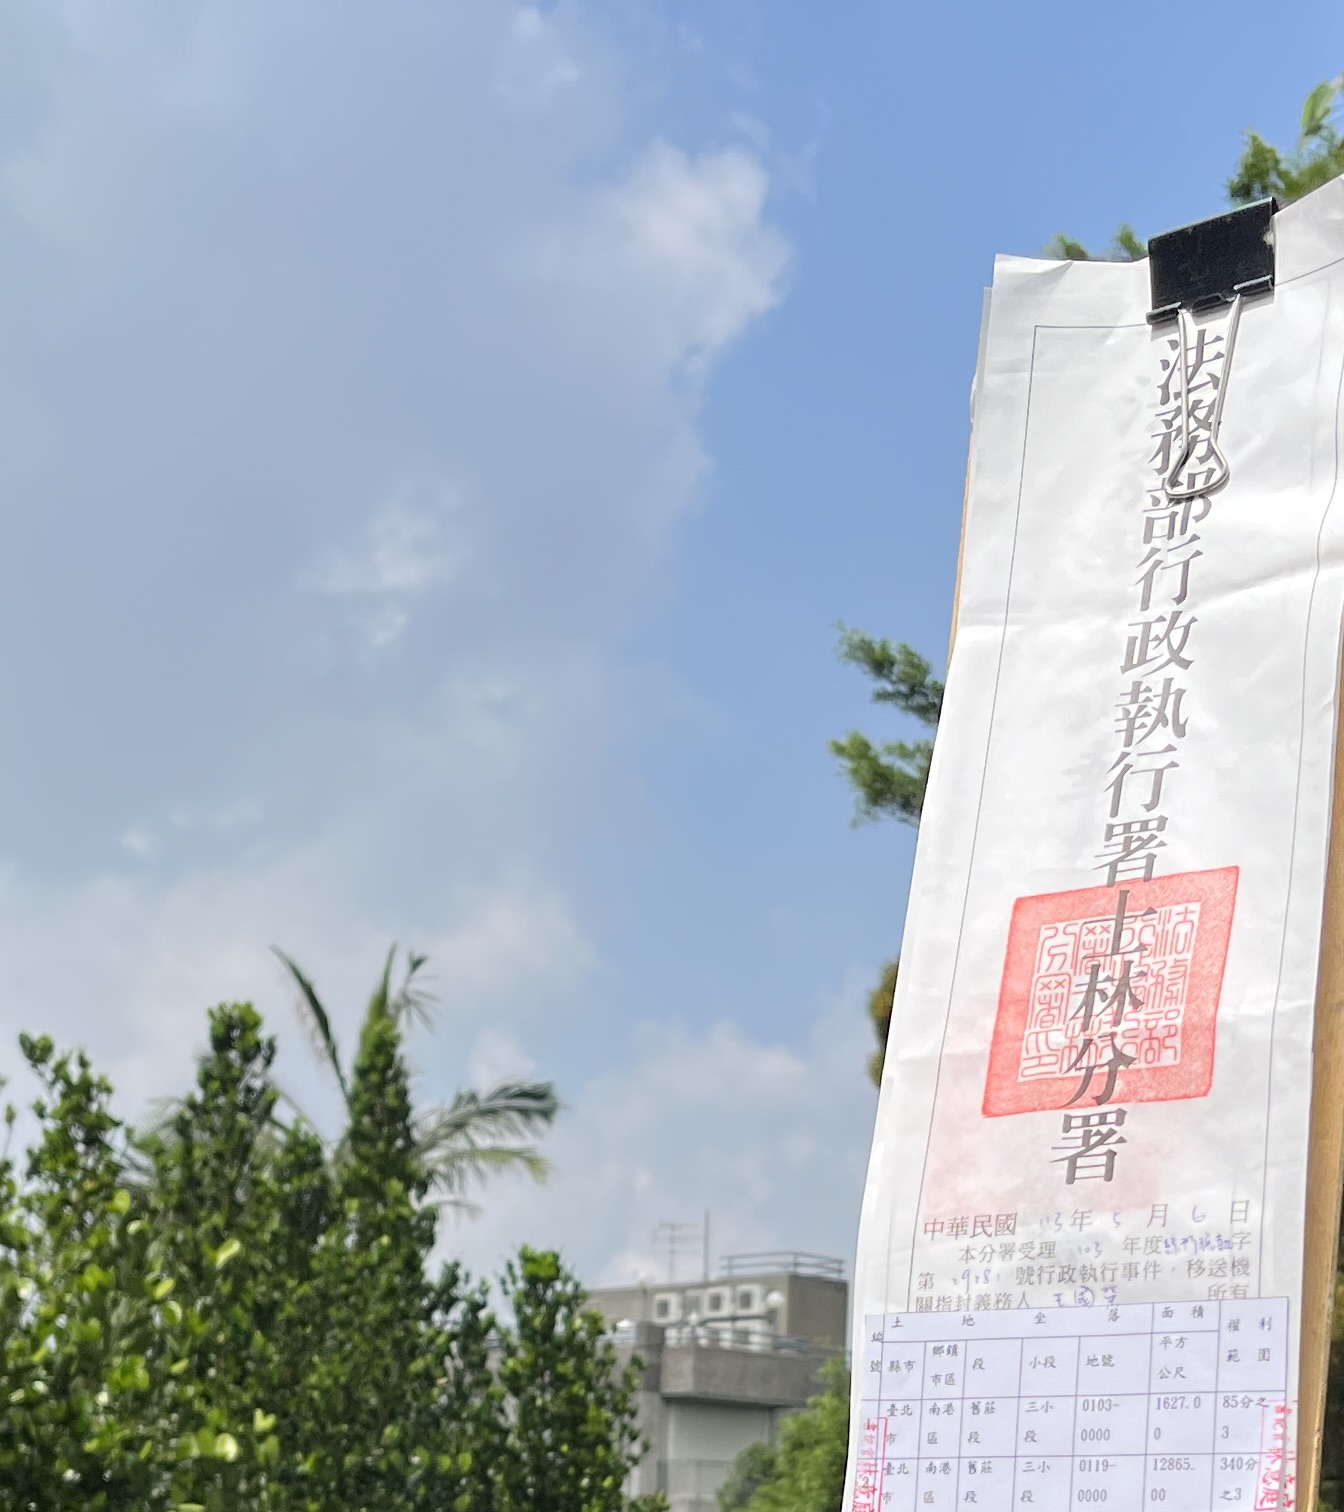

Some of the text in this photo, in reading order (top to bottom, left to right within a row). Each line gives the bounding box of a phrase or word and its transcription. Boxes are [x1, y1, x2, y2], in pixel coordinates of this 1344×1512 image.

[1051, 328, 1226, 1184] 法務部行政執行署士林分署
[923, 1212, 1018, 1241] 中華民國
[1070, 1208, 1094, 1232] 年
[1146, 1203, 1168, 1228] 月
[1230, 1199, 1250, 1224] 日
[959, 1240, 1057, 1264] 本分署受理
[917, 1272, 935, 1290] 第
[1159, 1336, 1189, 1350] 平方
[887, 1359, 916, 1374] 縣市
[972, 1357, 986, 1371] 段
[1028, 1355, 1057, 1370] 小段
[1085, 1354, 1115, 1368] 地號
[930, 1372, 957, 1387] 市區
[1157, 1366, 1187, 1380] 公尺
[928, 1402, 956, 1416] 南港
[1024, 1401, 1054, 1413] 三小
[1082, 1398, 1120, 1412] 0103-
[1222, 1395, 1270, 1409] 85分之
[886, 1403, 913, 1417] 臺北
[886, 1432, 898, 1446] 市
[927, 1431, 939, 1445] 區
[967, 1430, 981, 1444] 段
[1024, 1430, 1038, 1443] 段
[1080, 1428, 1111, 1442] 0000
[1153, 1427, 1162, 1440] 0
[1221, 1426, 1230, 1439] 3
[882, 1461, 910, 1475] 臺北
[925, 1461, 952, 1475] 南港
[1022, 1460, 1051, 1474] 三小
[1079, 1458, 1117, 1472] 0119-
[1219, 1457, 1258, 1471] 340分
[882, 1491, 894, 1505] 市
[923, 1490, 935, 1503] 區
[963, 1490, 978, 1503] 段
[1020, 1489, 1035, 1503] 段
[1077, 1488, 1108, 1502] 0000
[1150, 1488, 1166, 1501] 00
[1218, 1487, 1242, 1501] 之3
